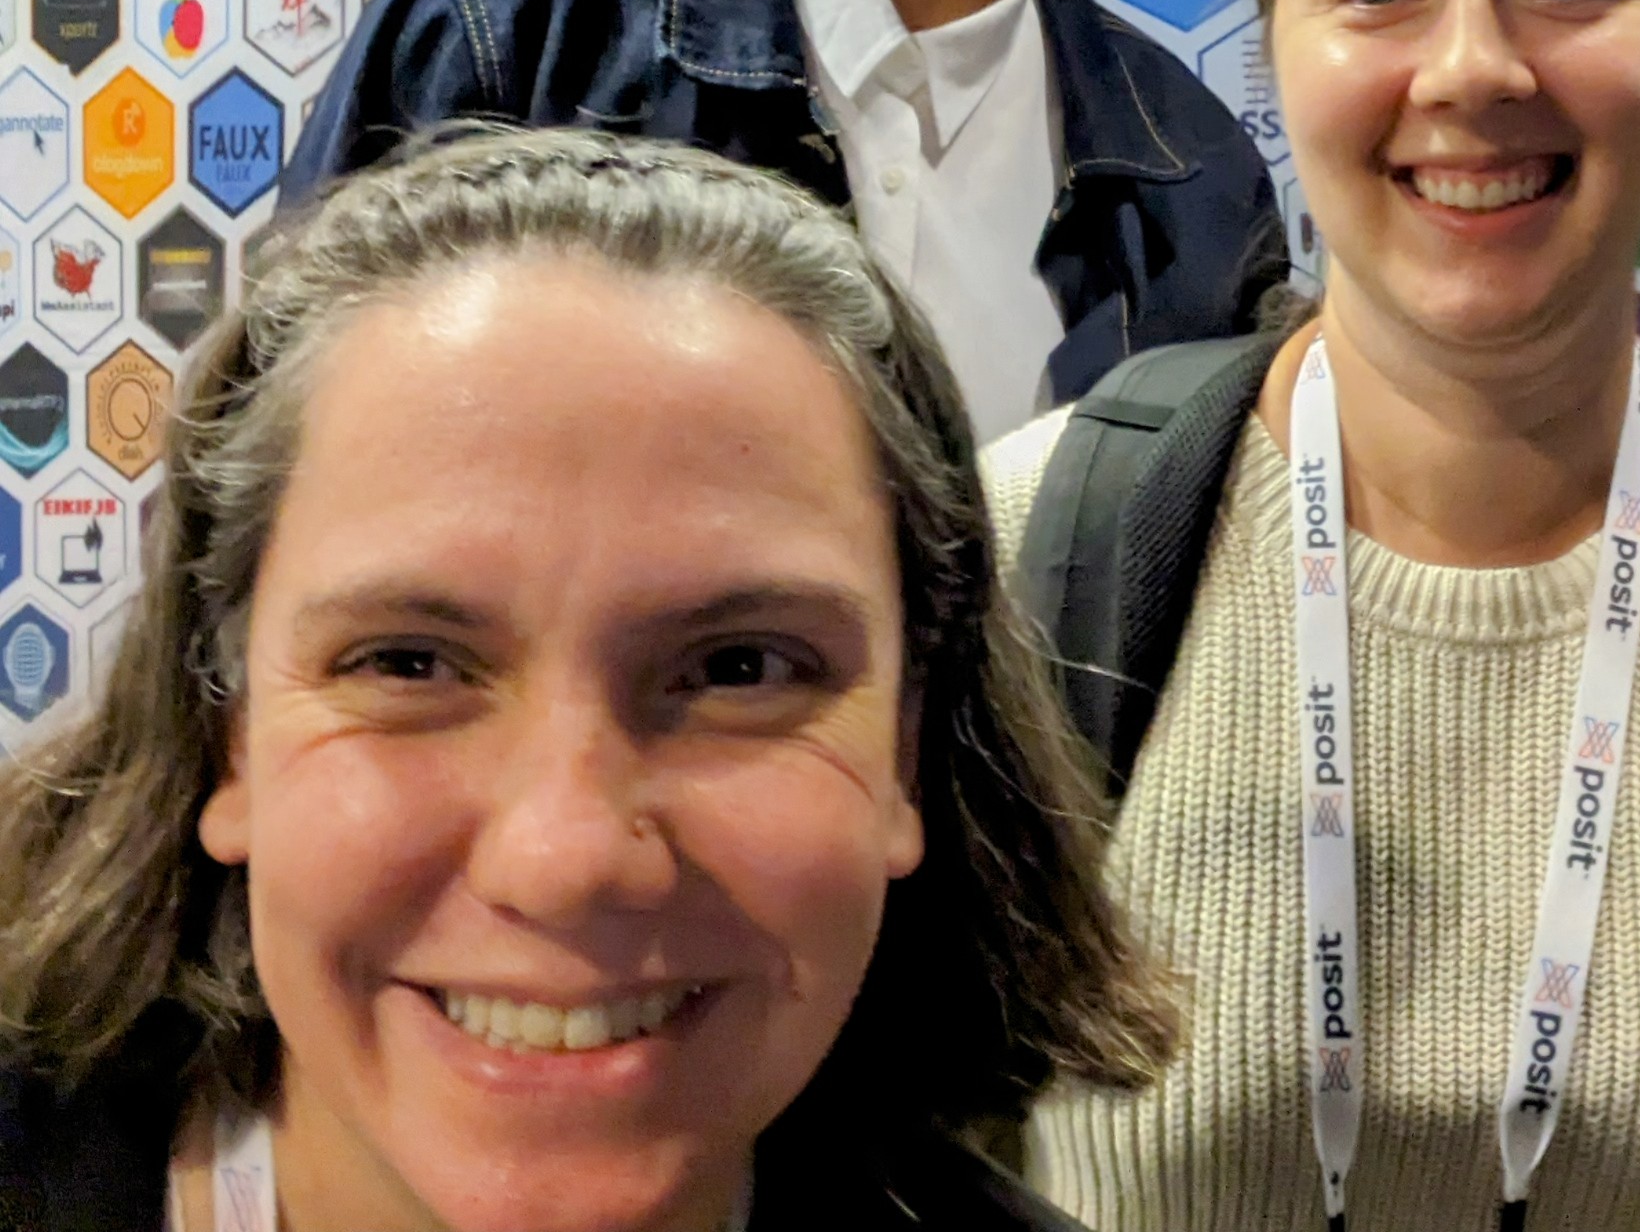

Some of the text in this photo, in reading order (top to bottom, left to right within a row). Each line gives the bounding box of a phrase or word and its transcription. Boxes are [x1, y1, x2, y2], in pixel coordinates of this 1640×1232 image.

[199, 124, 271, 161] FAUX
[1604, 534, 1639, 635] posit
[1312, 680, 1344, 788] posit
[1565, 764, 1604, 871] posit
[1313, 928, 1352, 1041] posit
[1315, 930, 1352, 1041] posit
[1519, 1009, 1562, 1116] posit
